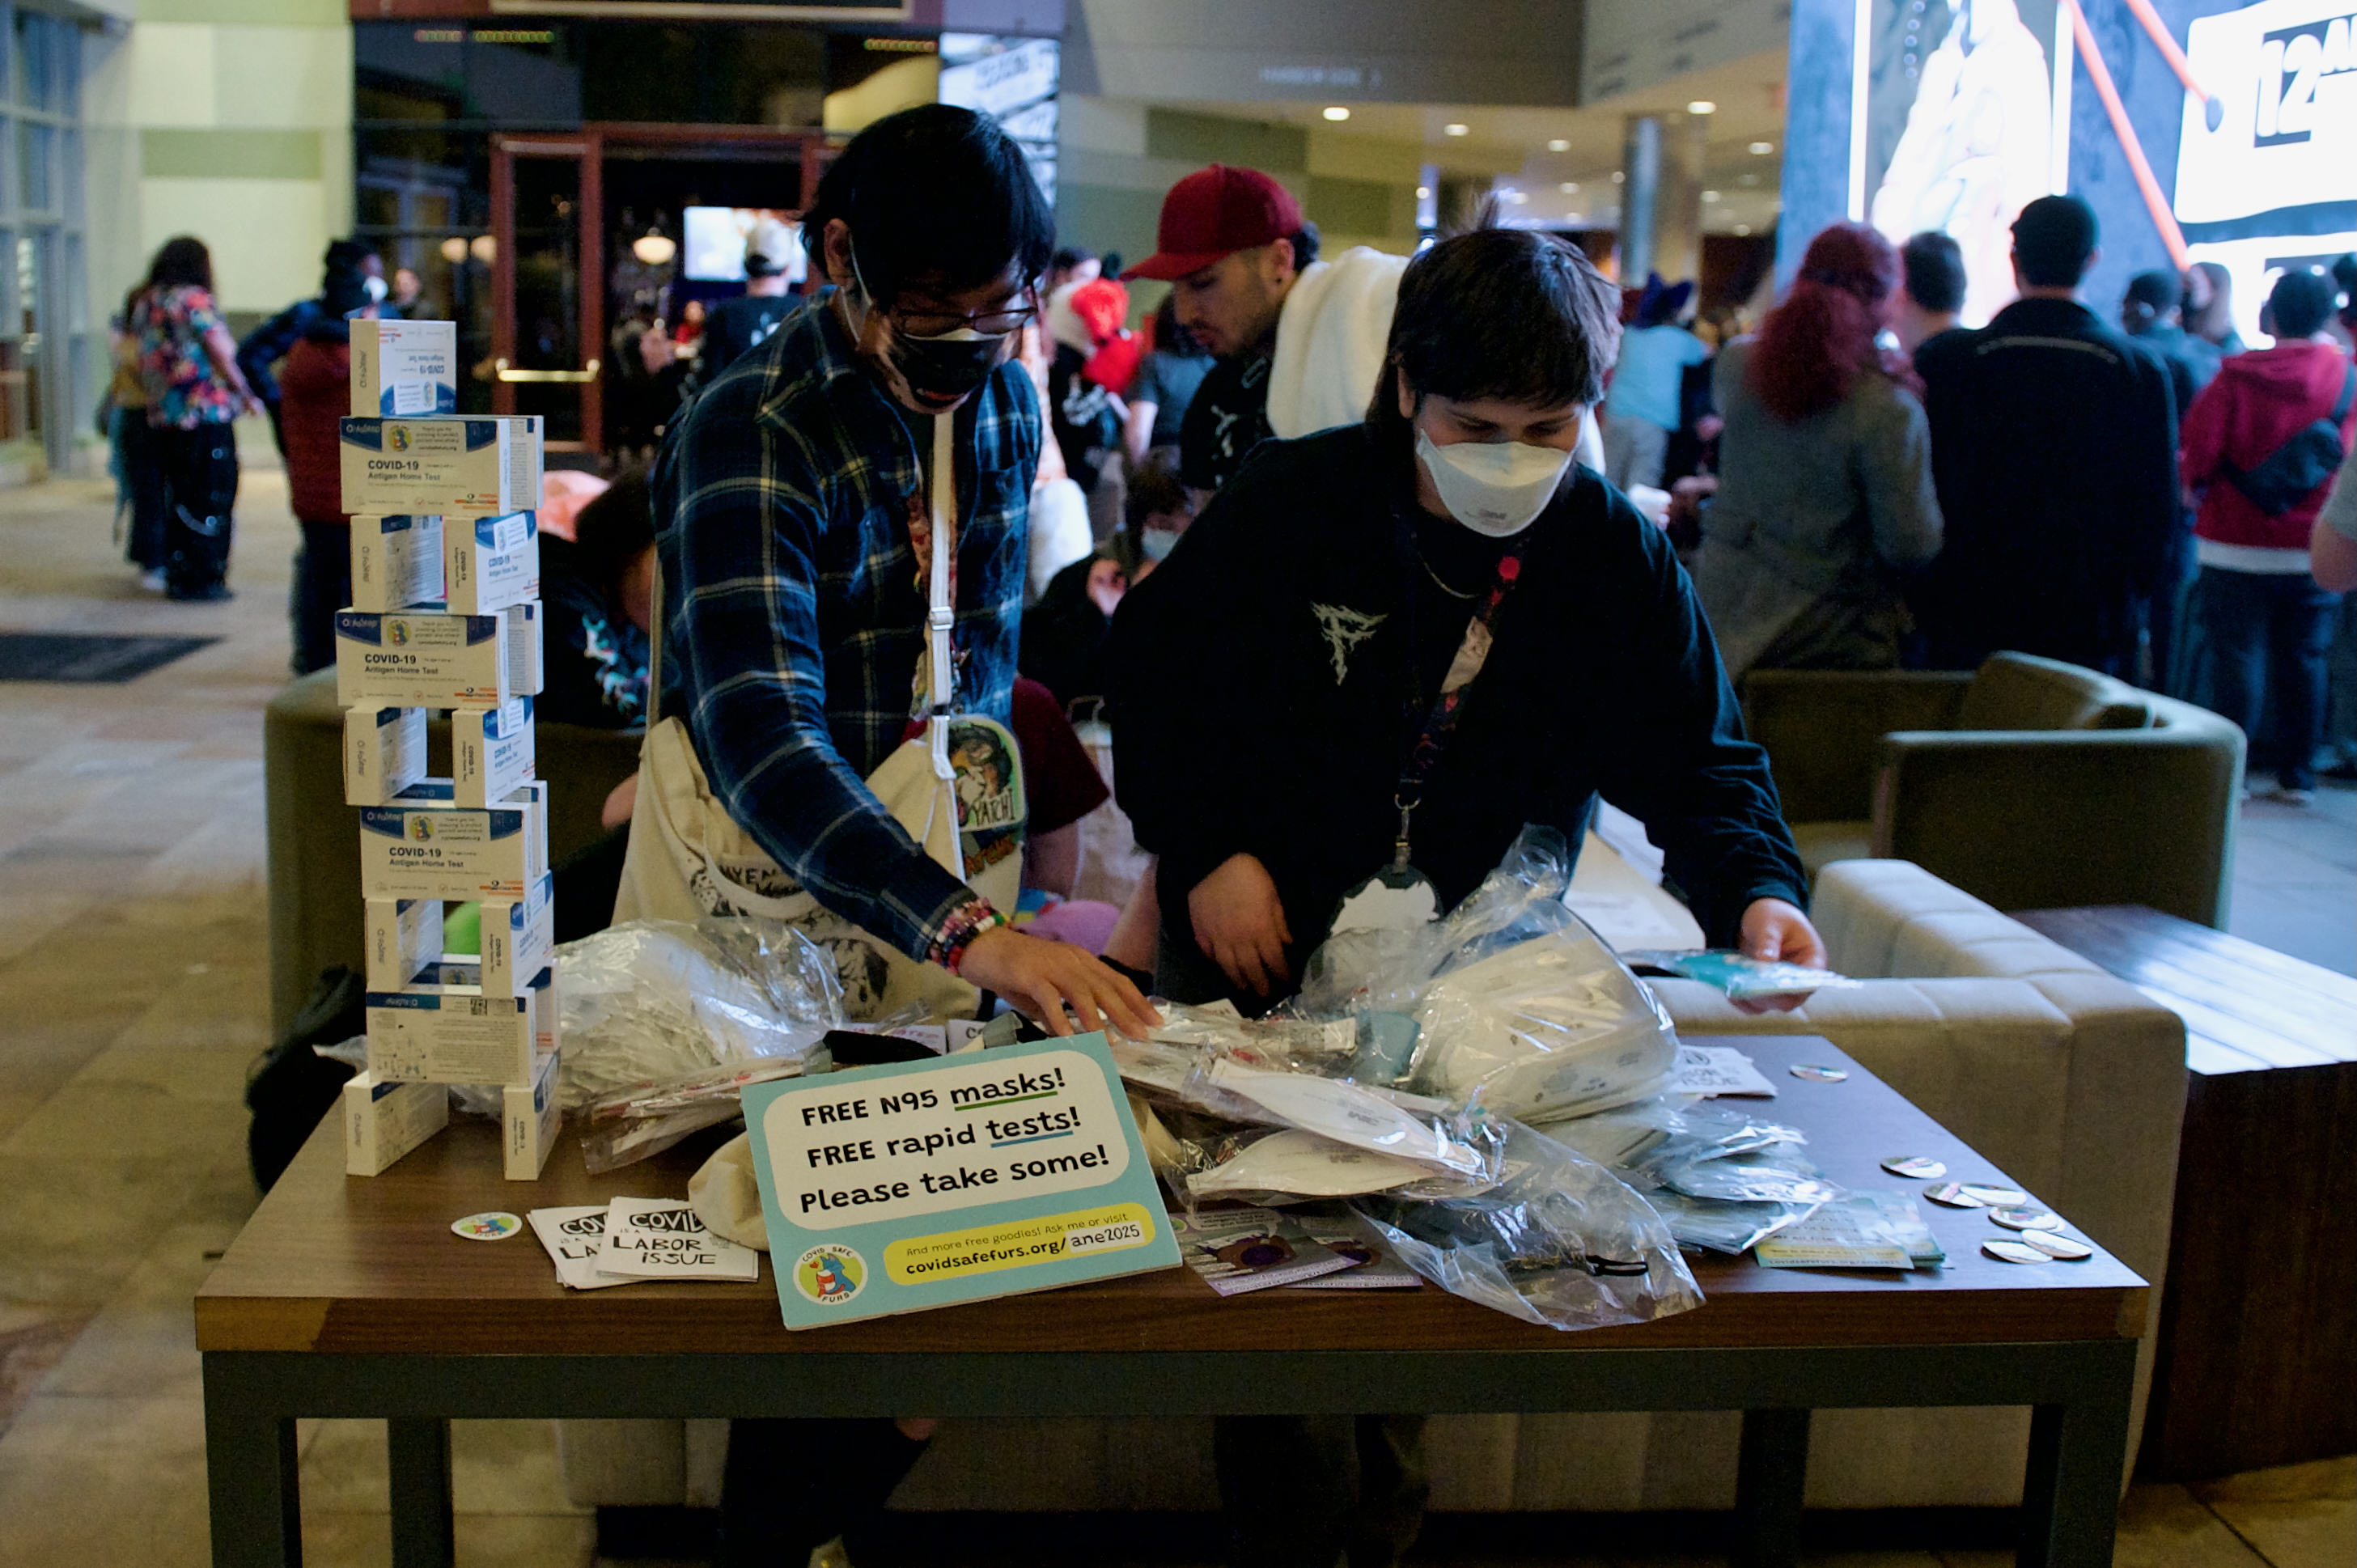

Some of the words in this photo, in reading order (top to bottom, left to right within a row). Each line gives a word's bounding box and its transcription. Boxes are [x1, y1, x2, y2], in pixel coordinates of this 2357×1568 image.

[367, 460, 419, 470] COVID-19
[367, 472, 397, 481] Antigen
[425, 473, 441, 481] Test
[365, 654, 416, 663] COVID-19
[365, 666, 395, 675] Antigen
[389, 847, 442, 857] COVID-19
[389, 858, 419, 867] Antigen
[801, 1100, 869, 1126] FREE
[880, 1090, 938, 1115] N95
[950, 1067, 1066, 1104] masks!
[807, 1140, 875, 1168] FREE
[887, 1124, 976, 1156] rapid
[986, 1106, 1081, 1140] tests!
[800, 1182, 909, 1213] Please
[920, 1168, 998, 1193] take
[1010, 1144, 1109, 1180] some!
[906, 1247, 928, 1257] And
[932, 1242, 962, 1252] more
[965, 1236, 989, 1247] free
[993, 1227, 1041, 1244] goodies!
[1045, 1224, 1063, 1234] Ask
[1067, 1220, 1085, 1229] me
[1088, 1218, 1100, 1227] or
[1104, 1213, 1128, 1224] visit
[613, 1235, 702, 1251] LABOR
[803, 1248, 825, 1262] COVID
[832, 1247, 853, 1257] SAFE
[822, 1292, 850, 1303] FURS
